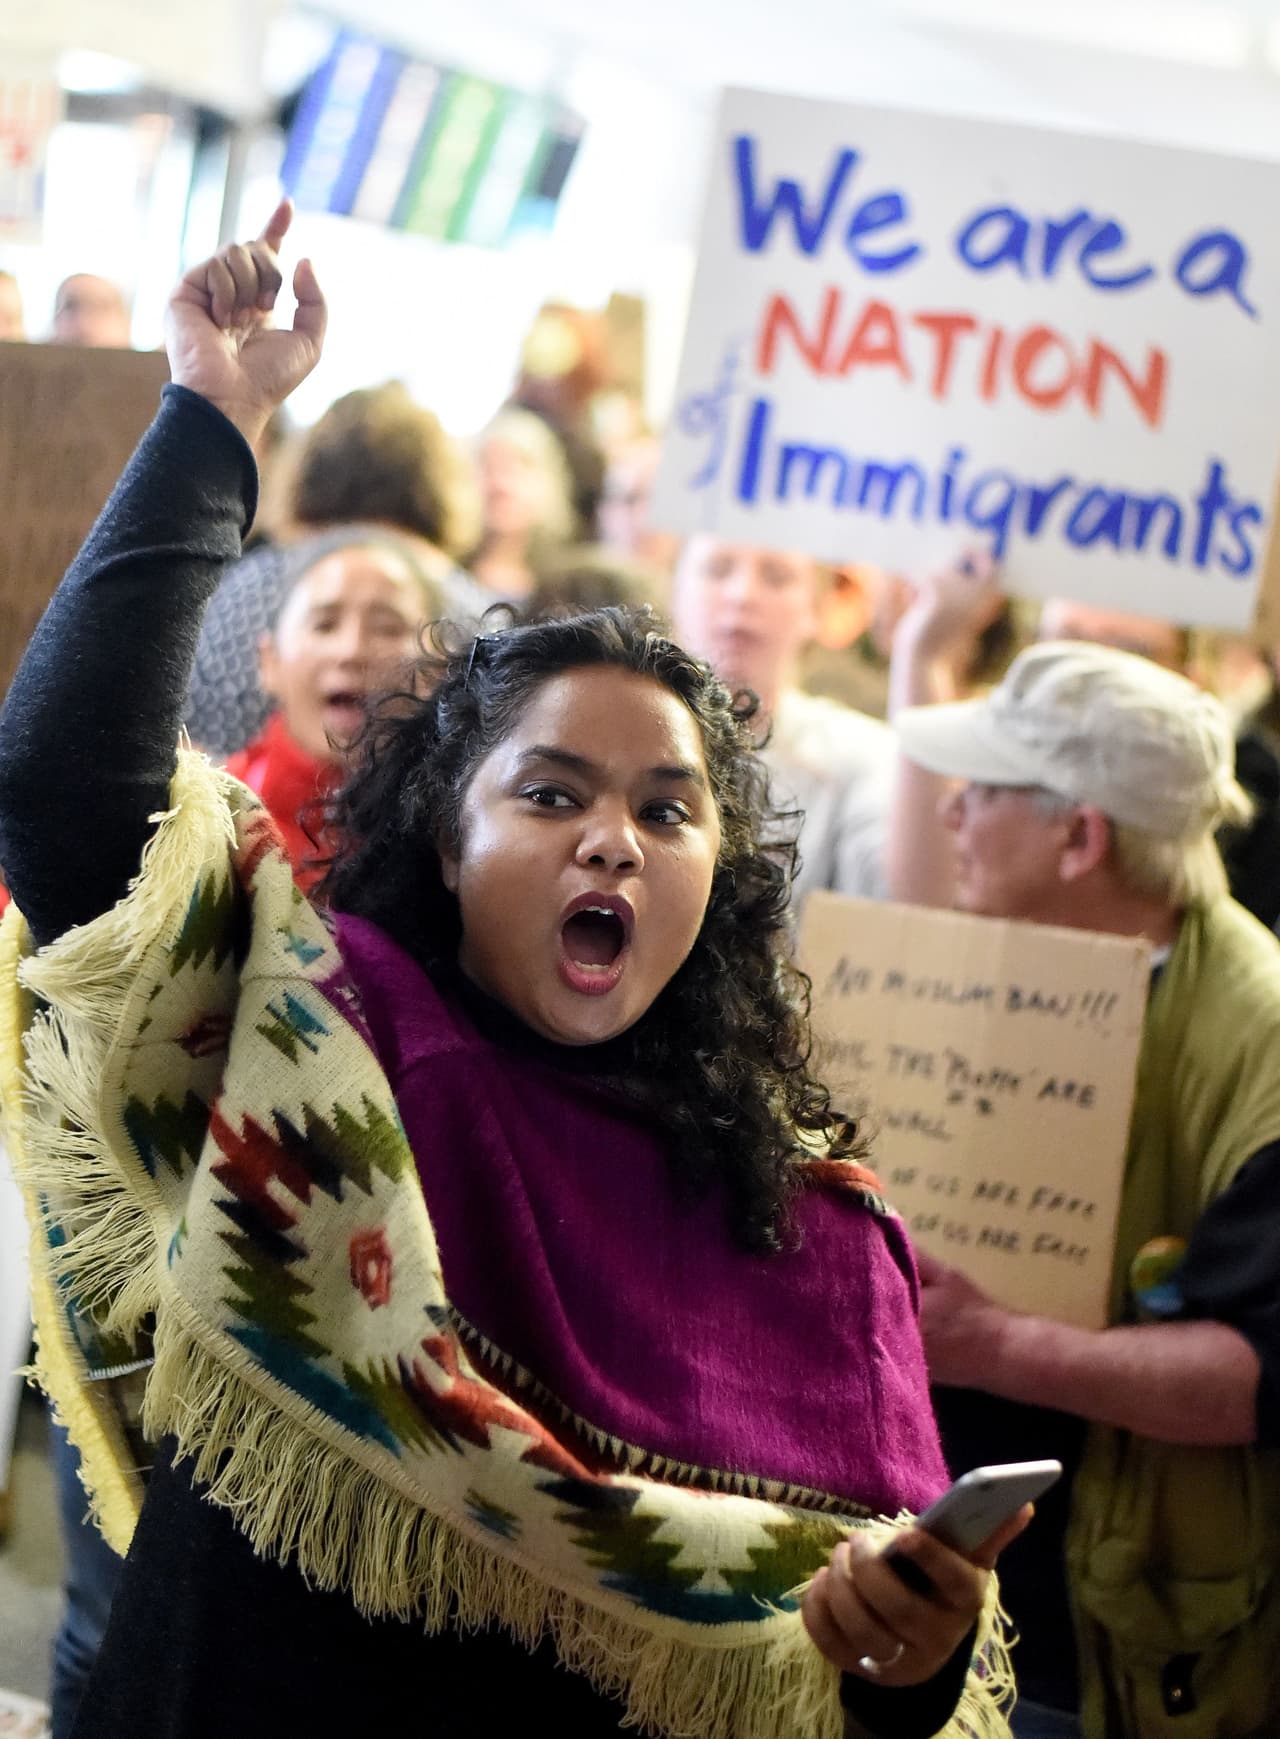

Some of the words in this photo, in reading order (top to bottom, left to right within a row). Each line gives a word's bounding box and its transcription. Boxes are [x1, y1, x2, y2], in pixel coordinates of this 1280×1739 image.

[732, 133, 925, 273] We
[956, 201, 1156, 290] are
[1173, 229, 1259, 323] a
[754, 284, 1169, 432] NATION
[736, 396, 1265, 578] Immigrants
